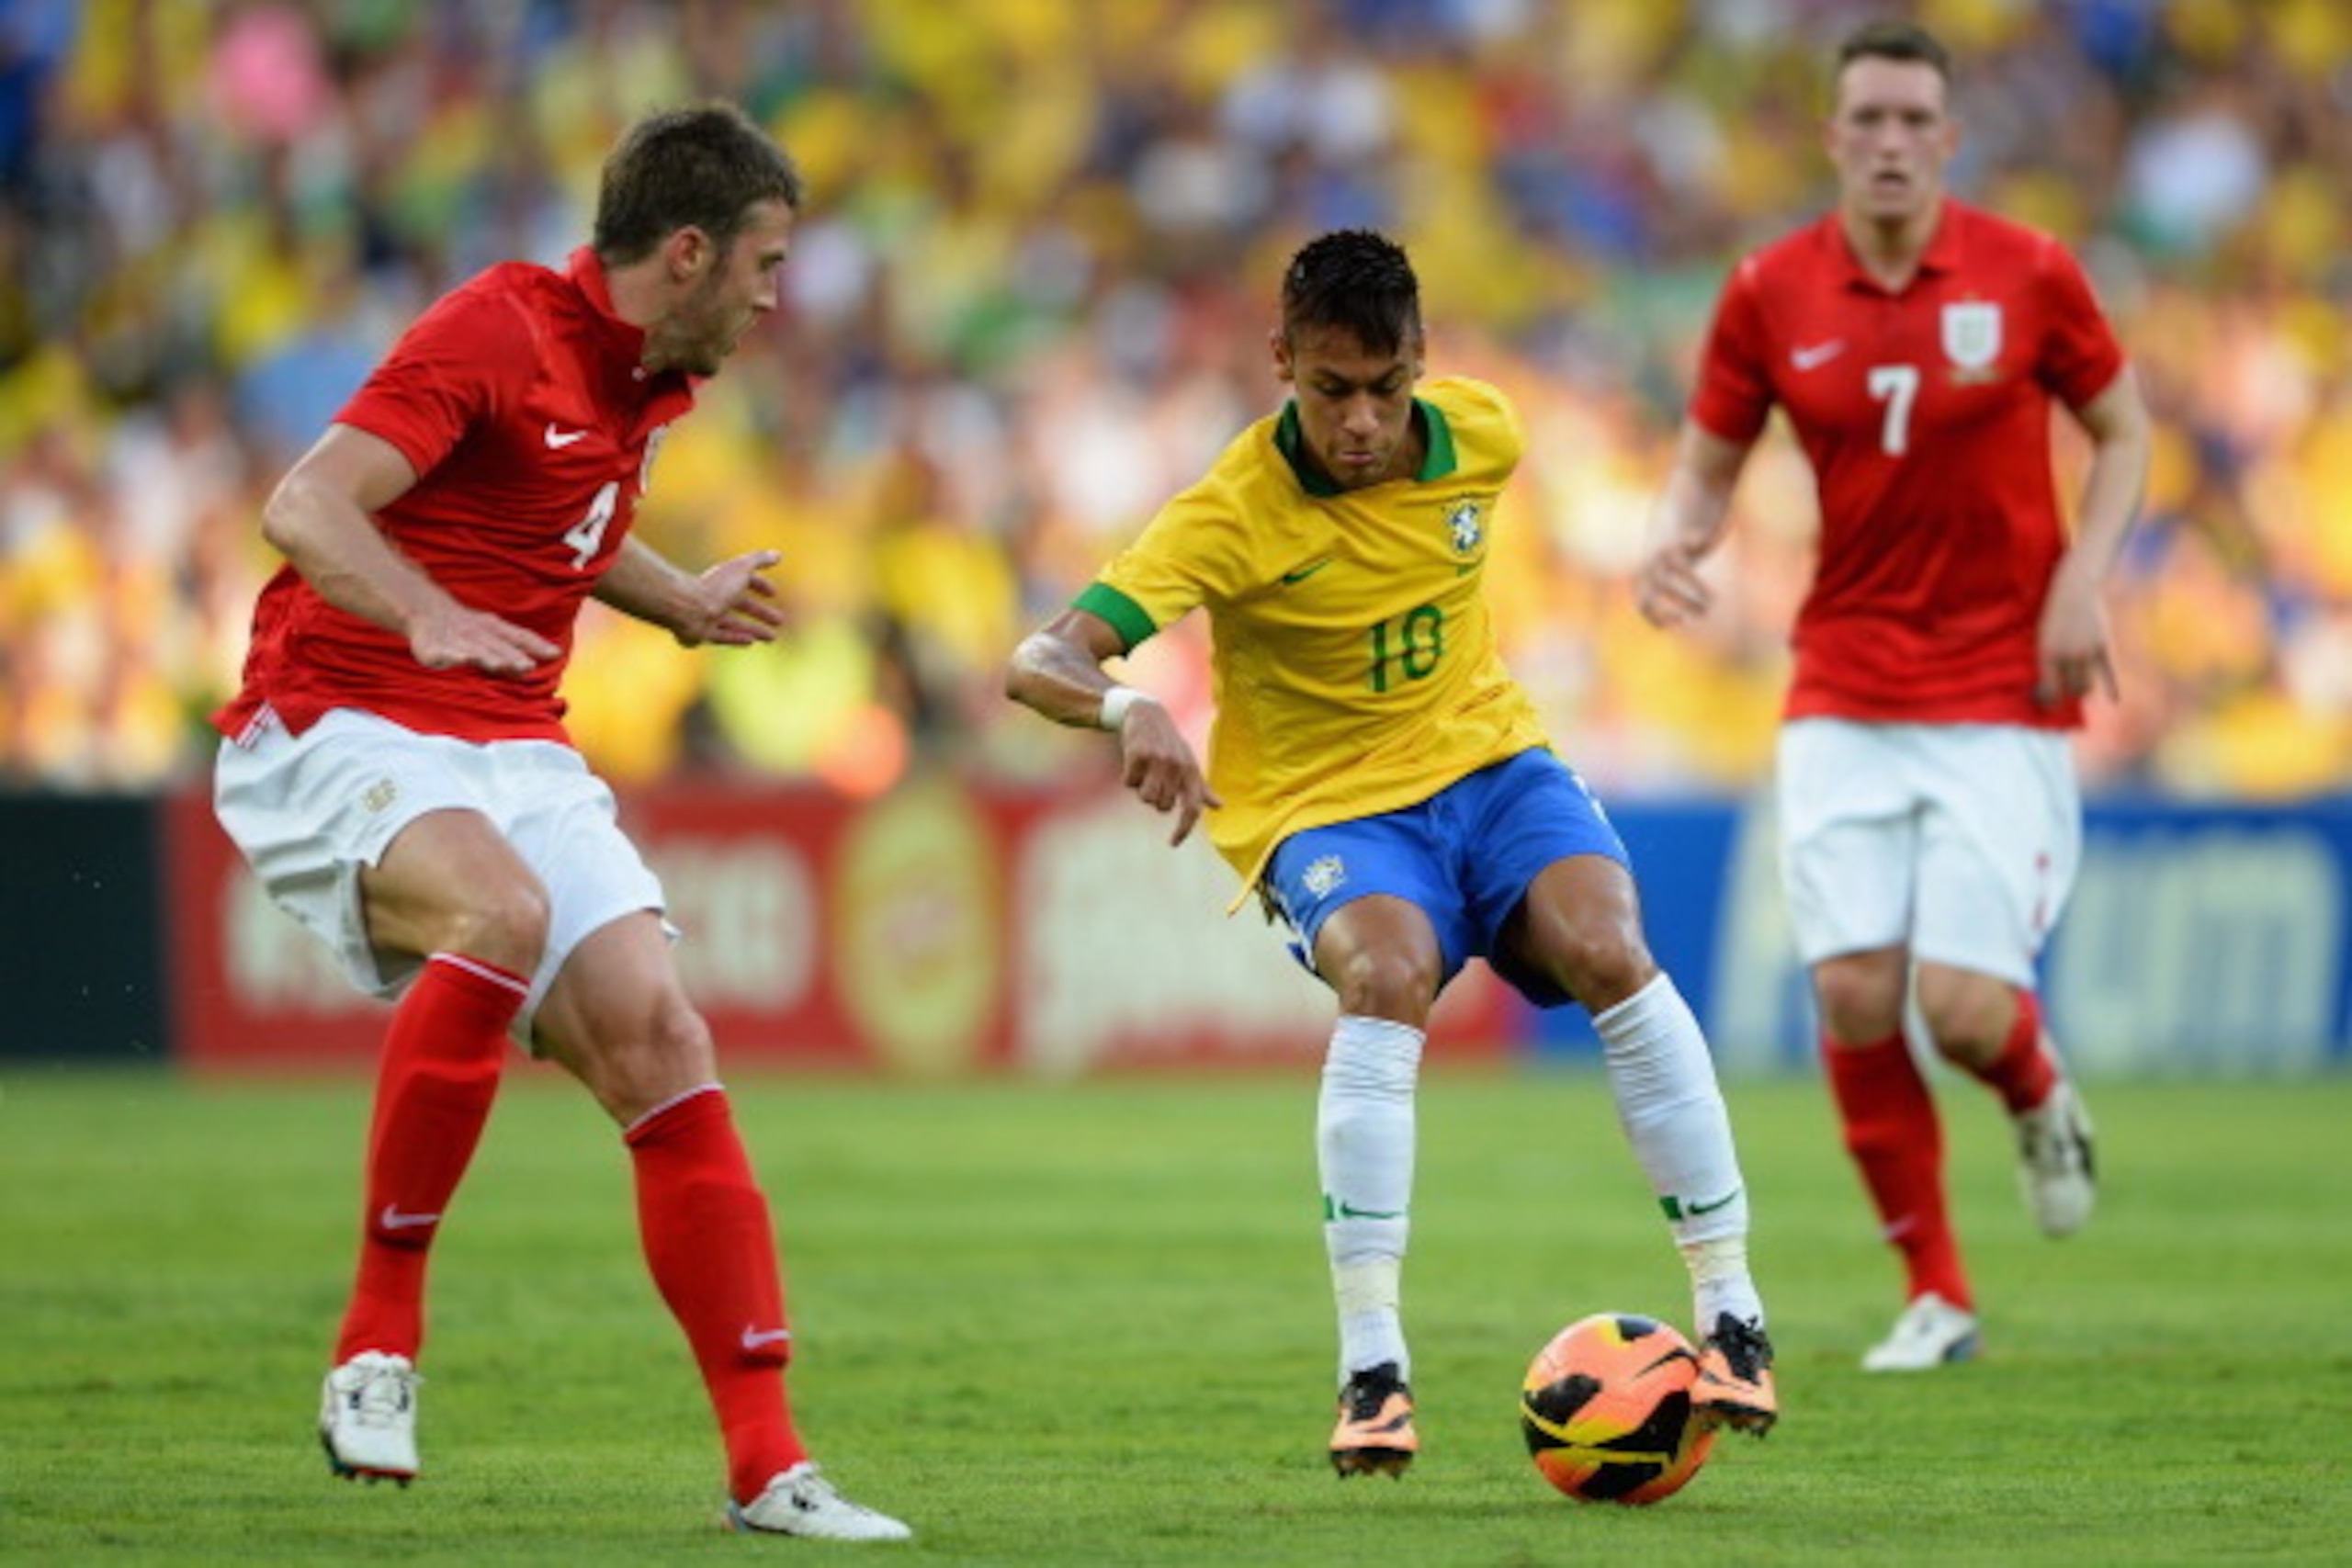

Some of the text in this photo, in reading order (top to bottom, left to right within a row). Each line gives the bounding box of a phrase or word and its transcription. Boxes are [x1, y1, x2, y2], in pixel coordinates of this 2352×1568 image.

[1868, 365, 1920, 456] 7
[562, 480, 620, 572] 4
[1372, 605, 1443, 693] 10
